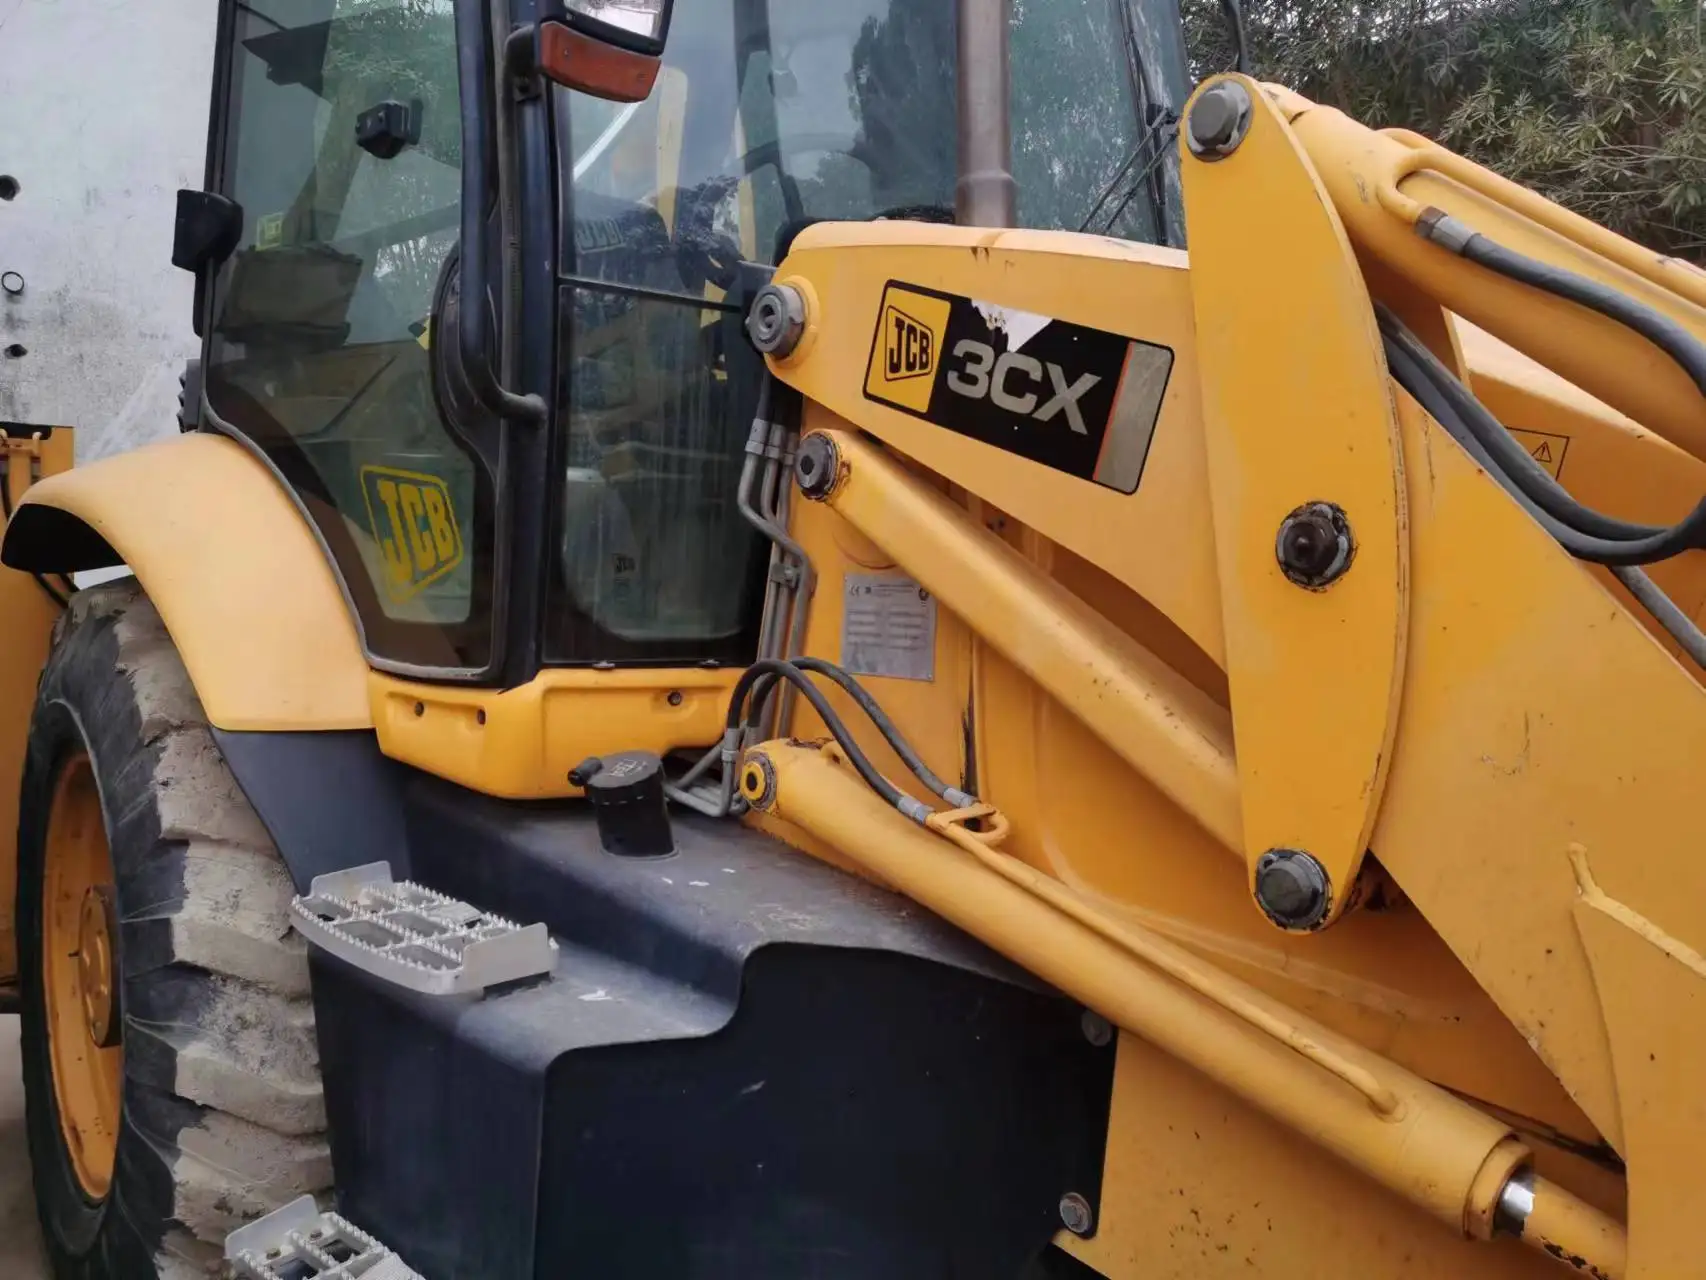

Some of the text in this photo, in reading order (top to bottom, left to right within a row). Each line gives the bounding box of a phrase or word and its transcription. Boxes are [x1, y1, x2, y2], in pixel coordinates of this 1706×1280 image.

[889, 316, 930, 374] JCB
[947, 339, 1102, 435] 3CX
[377, 478, 454, 583] JCB
